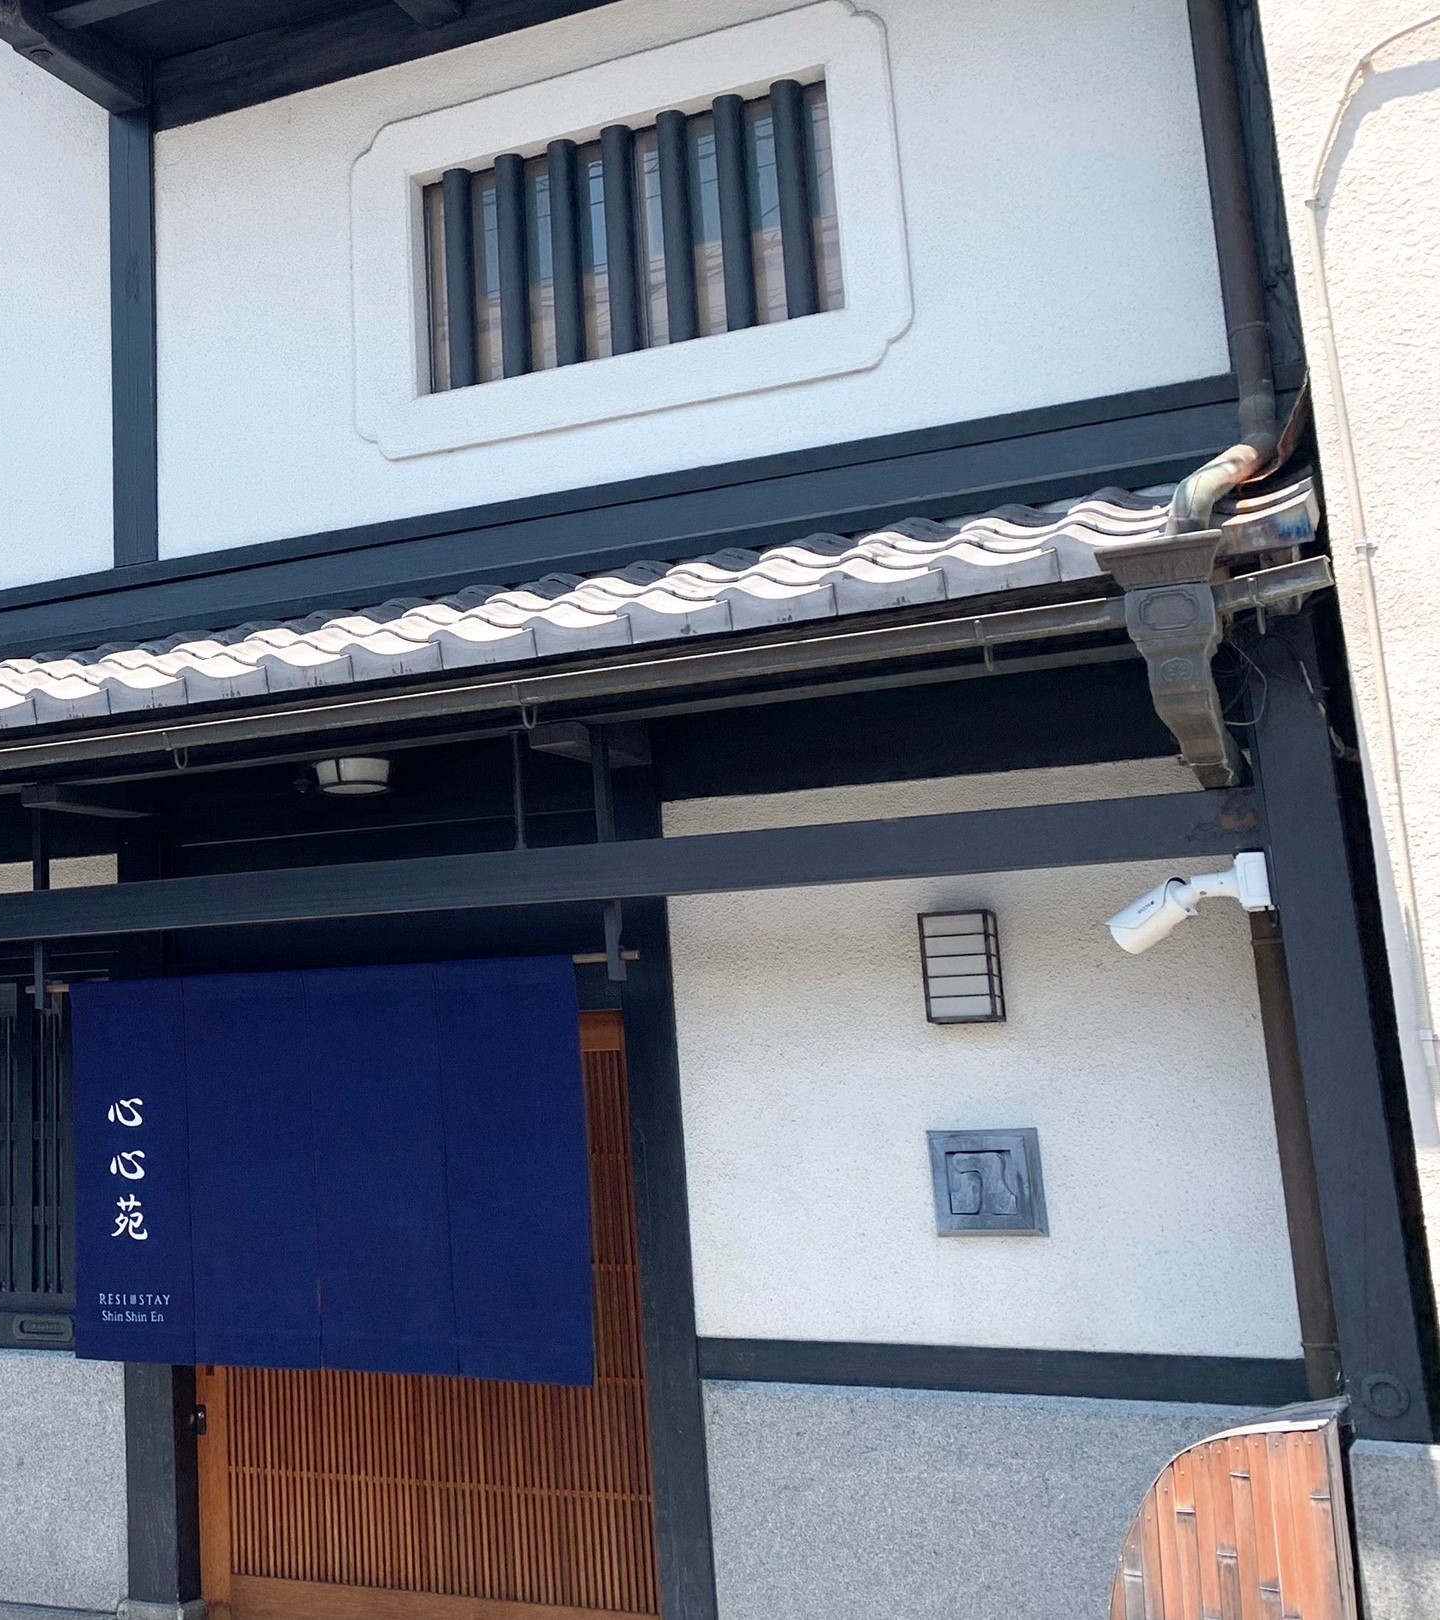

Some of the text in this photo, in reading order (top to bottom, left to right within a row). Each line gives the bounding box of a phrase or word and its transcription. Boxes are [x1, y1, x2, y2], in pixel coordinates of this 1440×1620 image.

[107, 1097, 149, 1241] 心心苑
[139, 1293, 171, 1306] STAY
[101, 1309, 164, 1322] Shin Shin En
